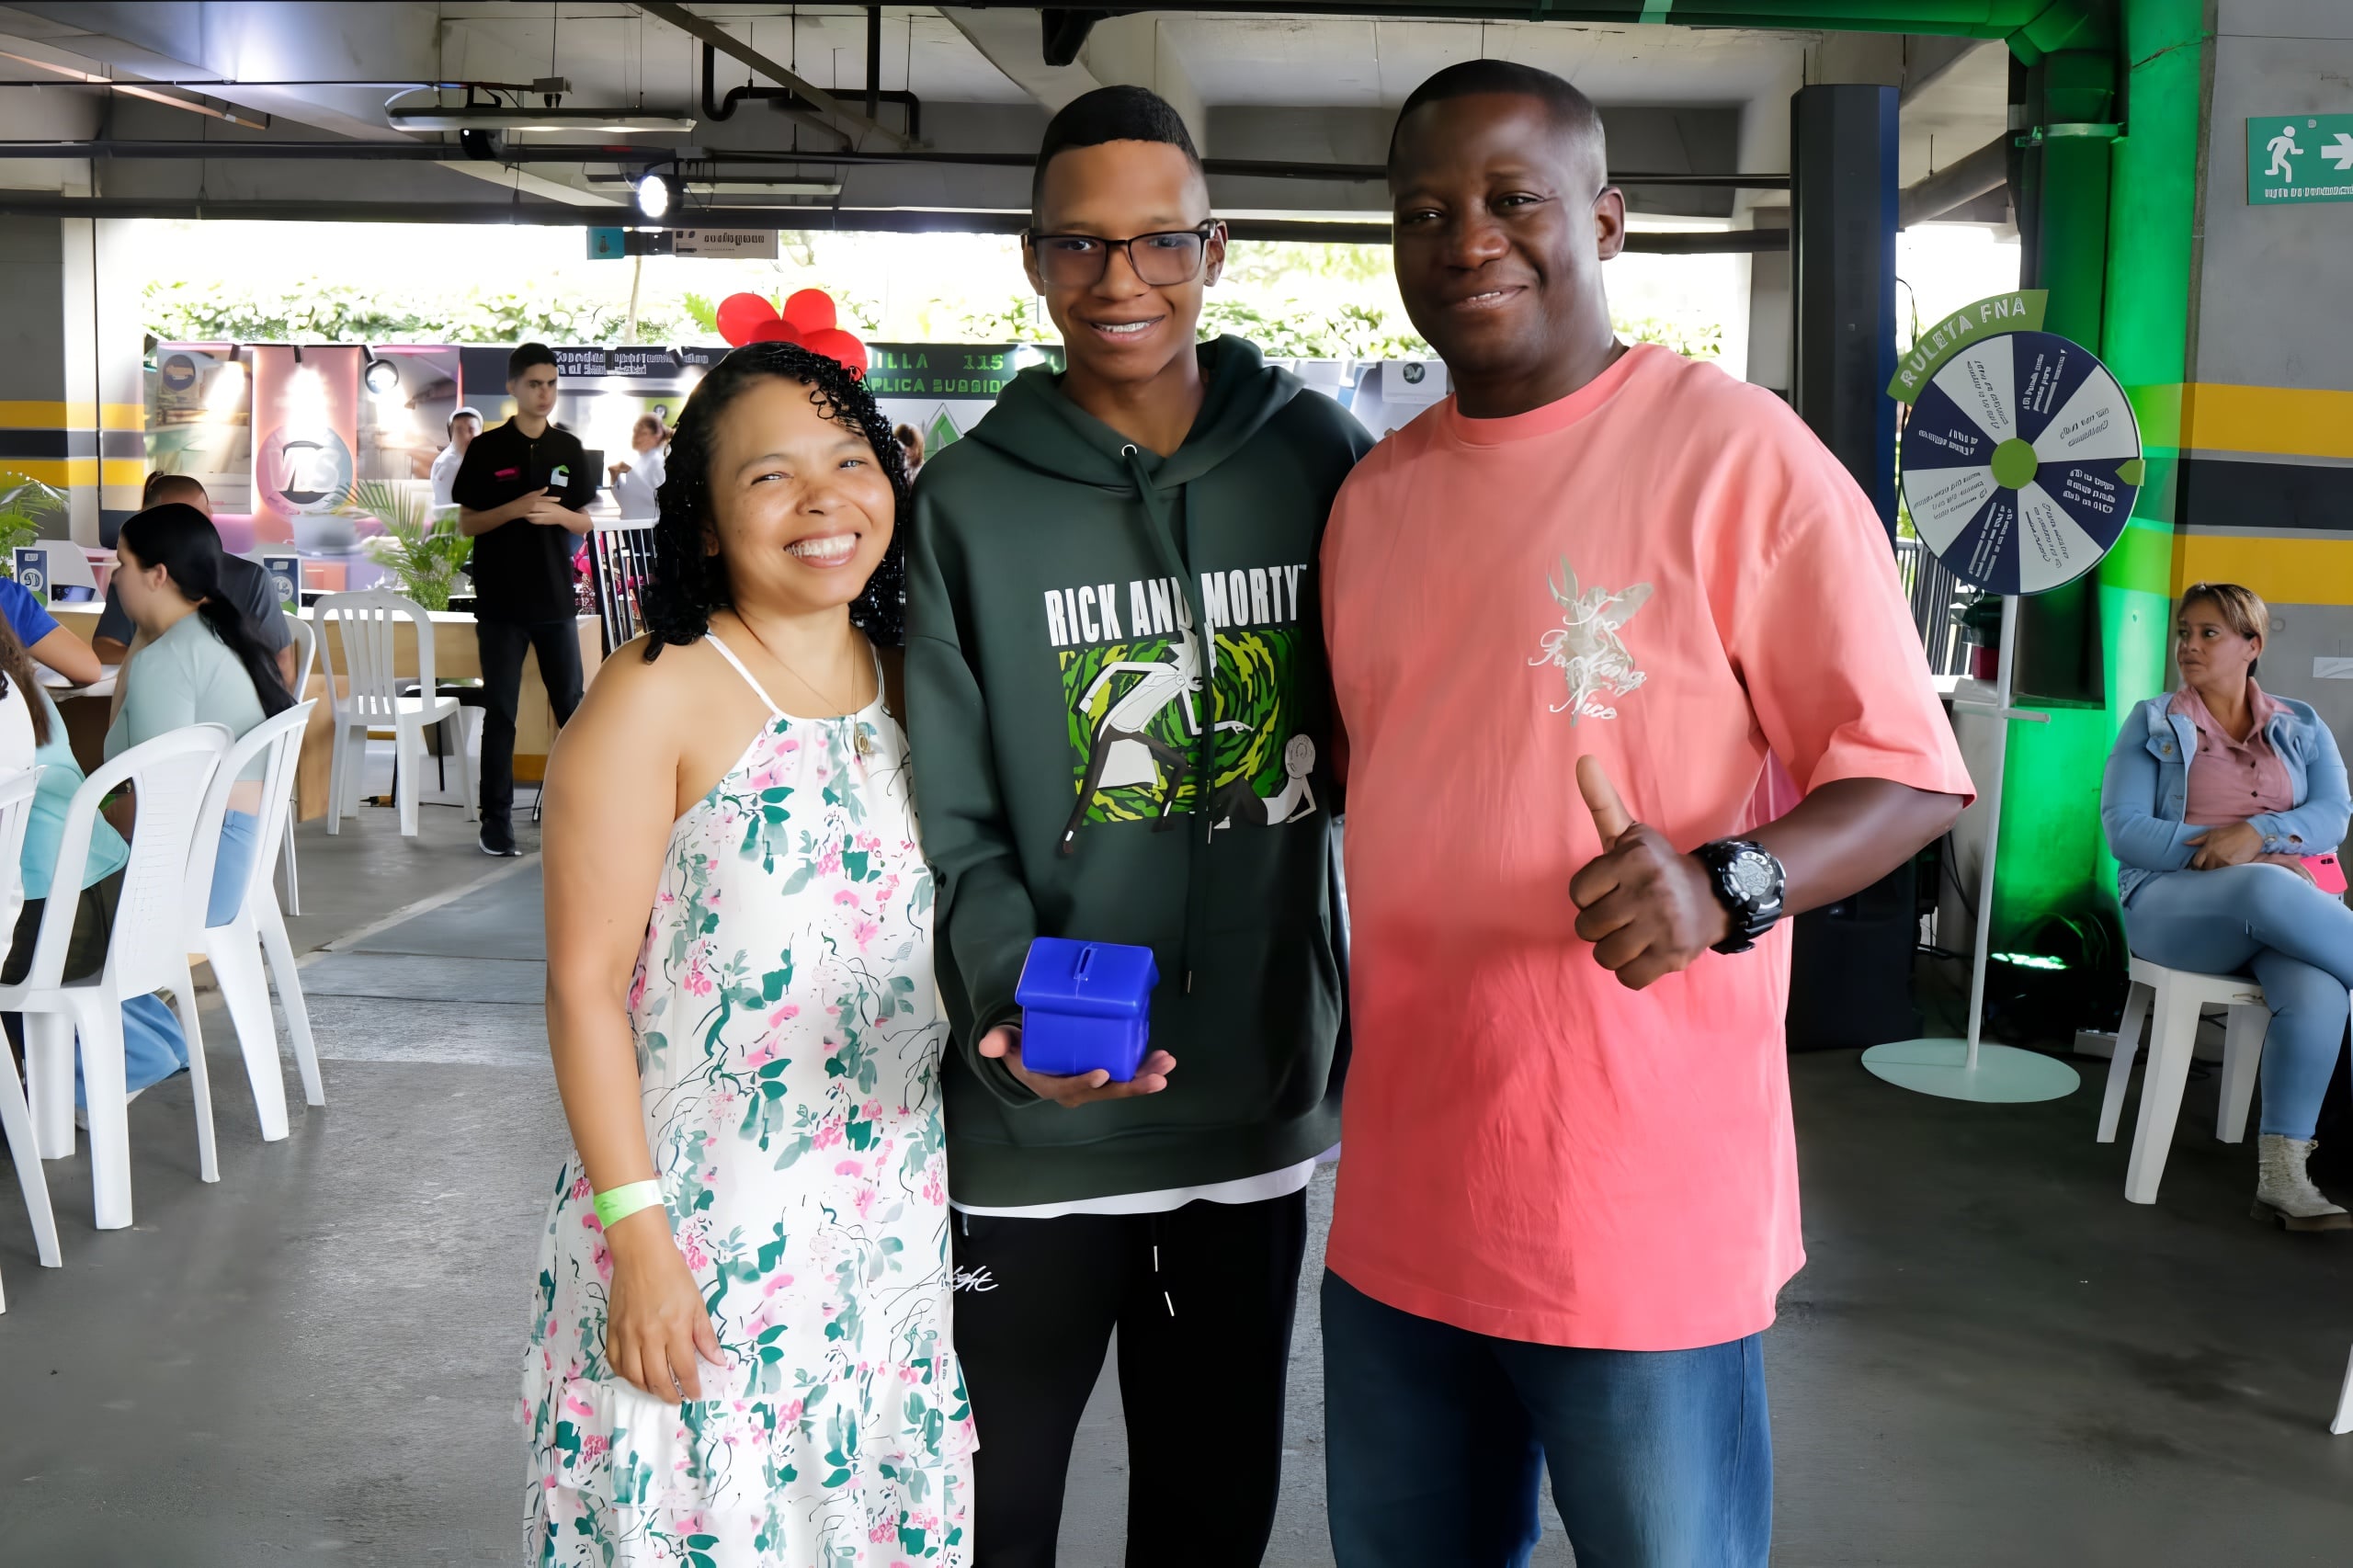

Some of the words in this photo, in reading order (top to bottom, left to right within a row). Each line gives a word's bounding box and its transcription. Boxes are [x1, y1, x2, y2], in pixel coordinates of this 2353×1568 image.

[876, 353, 928, 369] ILLA
[1900, 315, 1973, 388] RULETA
[1980, 297, 2026, 324] FNA
[1044, 584, 1122, 647] RICK
[1130, 576, 1194, 637] AND
[1200, 564, 1300, 629] MORTY
